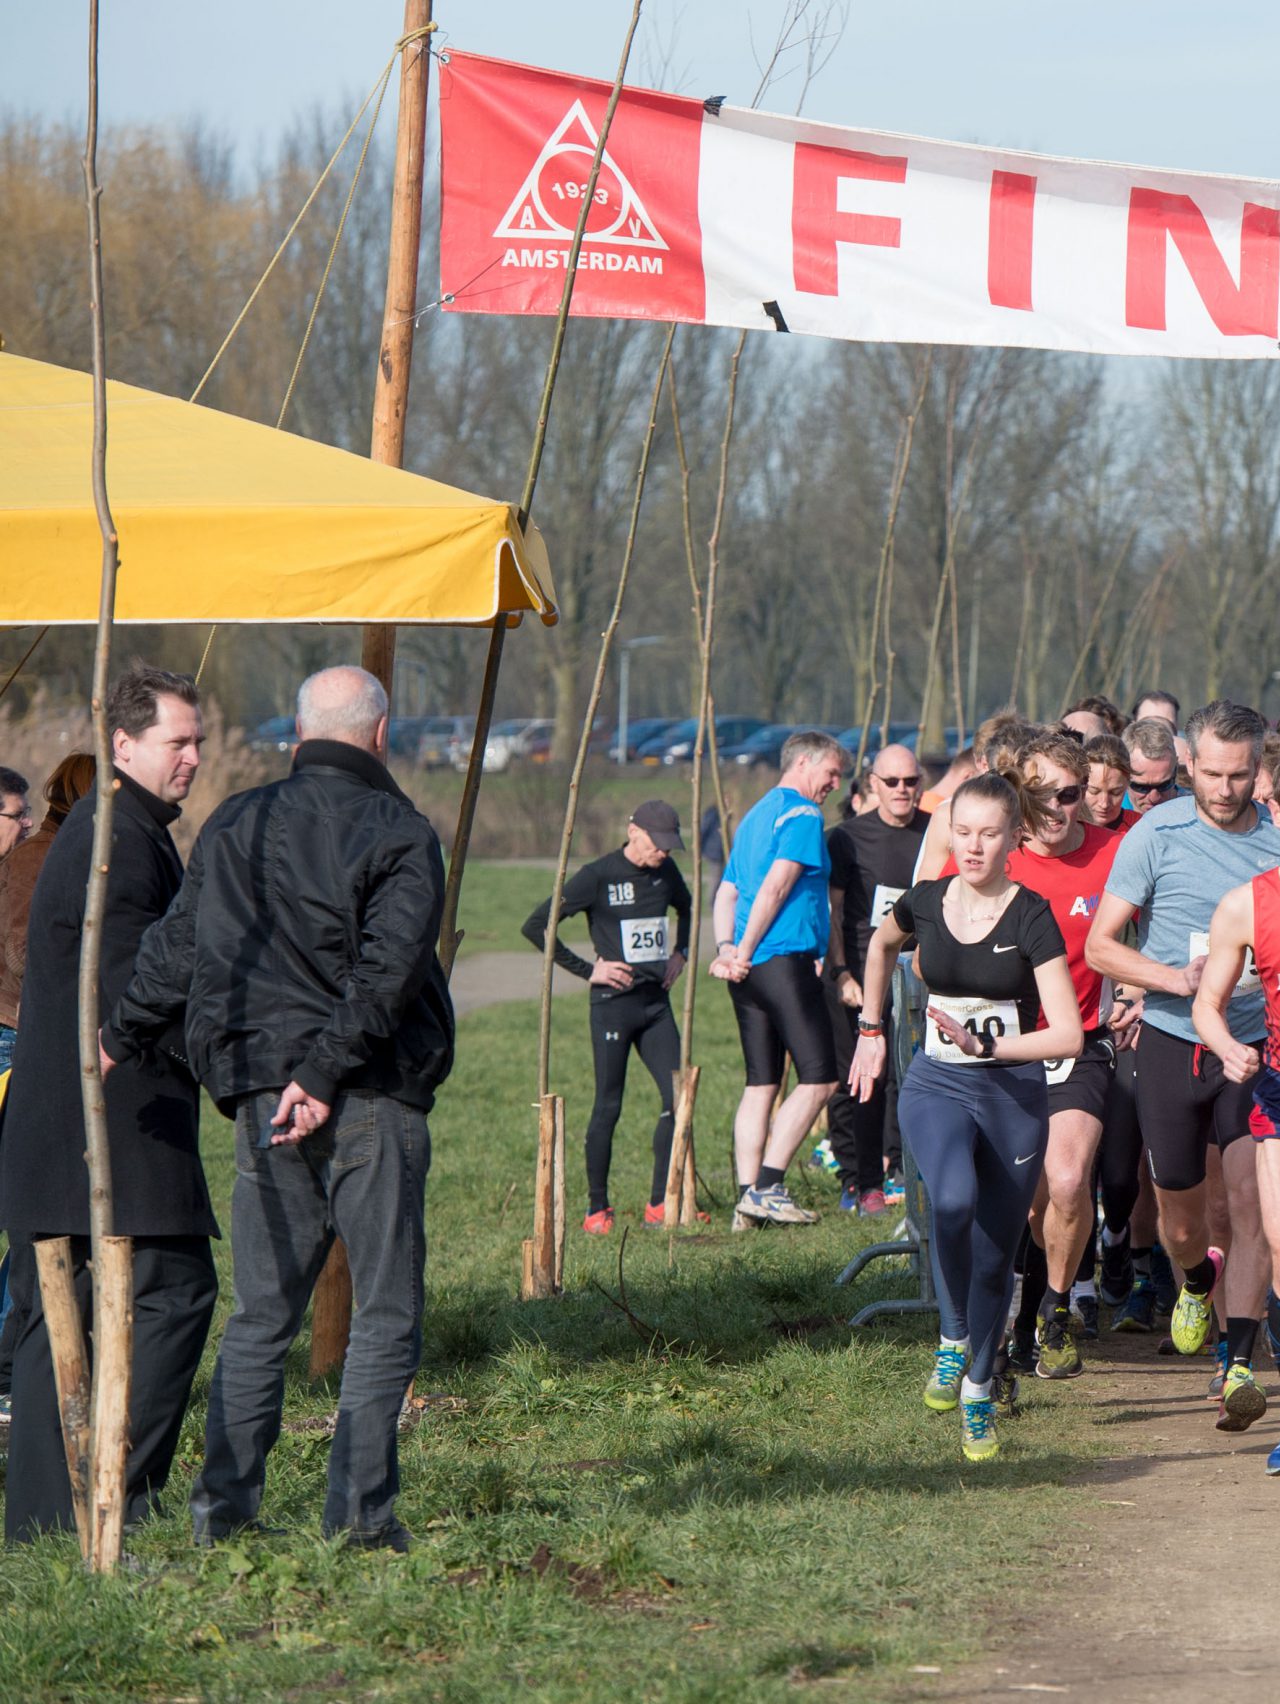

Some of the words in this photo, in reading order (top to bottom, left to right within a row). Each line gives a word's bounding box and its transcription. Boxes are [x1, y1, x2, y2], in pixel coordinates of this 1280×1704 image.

[519, 205, 537, 229] A
[628, 217, 641, 238] V
[501, 248, 663, 275] AMSTERDAM
[631, 930, 664, 949] 250
